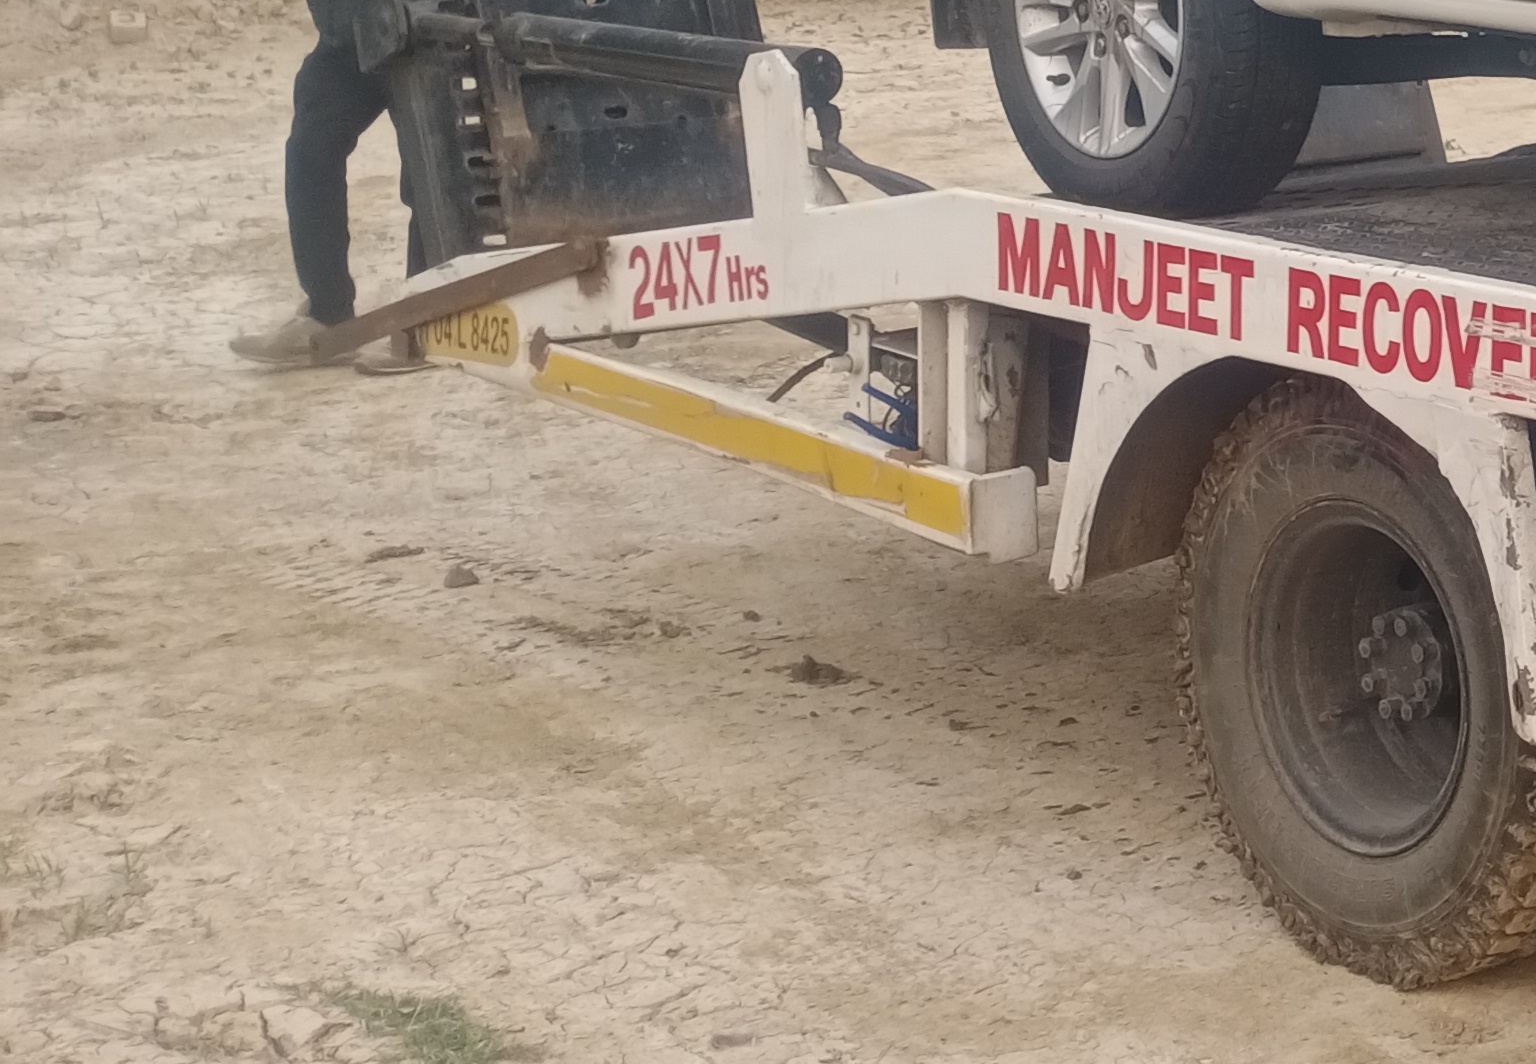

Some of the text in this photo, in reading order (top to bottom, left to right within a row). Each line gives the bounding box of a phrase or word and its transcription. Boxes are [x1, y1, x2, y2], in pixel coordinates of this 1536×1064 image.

[629, 234, 770, 321] 24X7 Hrs
[996, 212, 1255, 341] MANJEET
[470, 311, 510, 356] 8425
